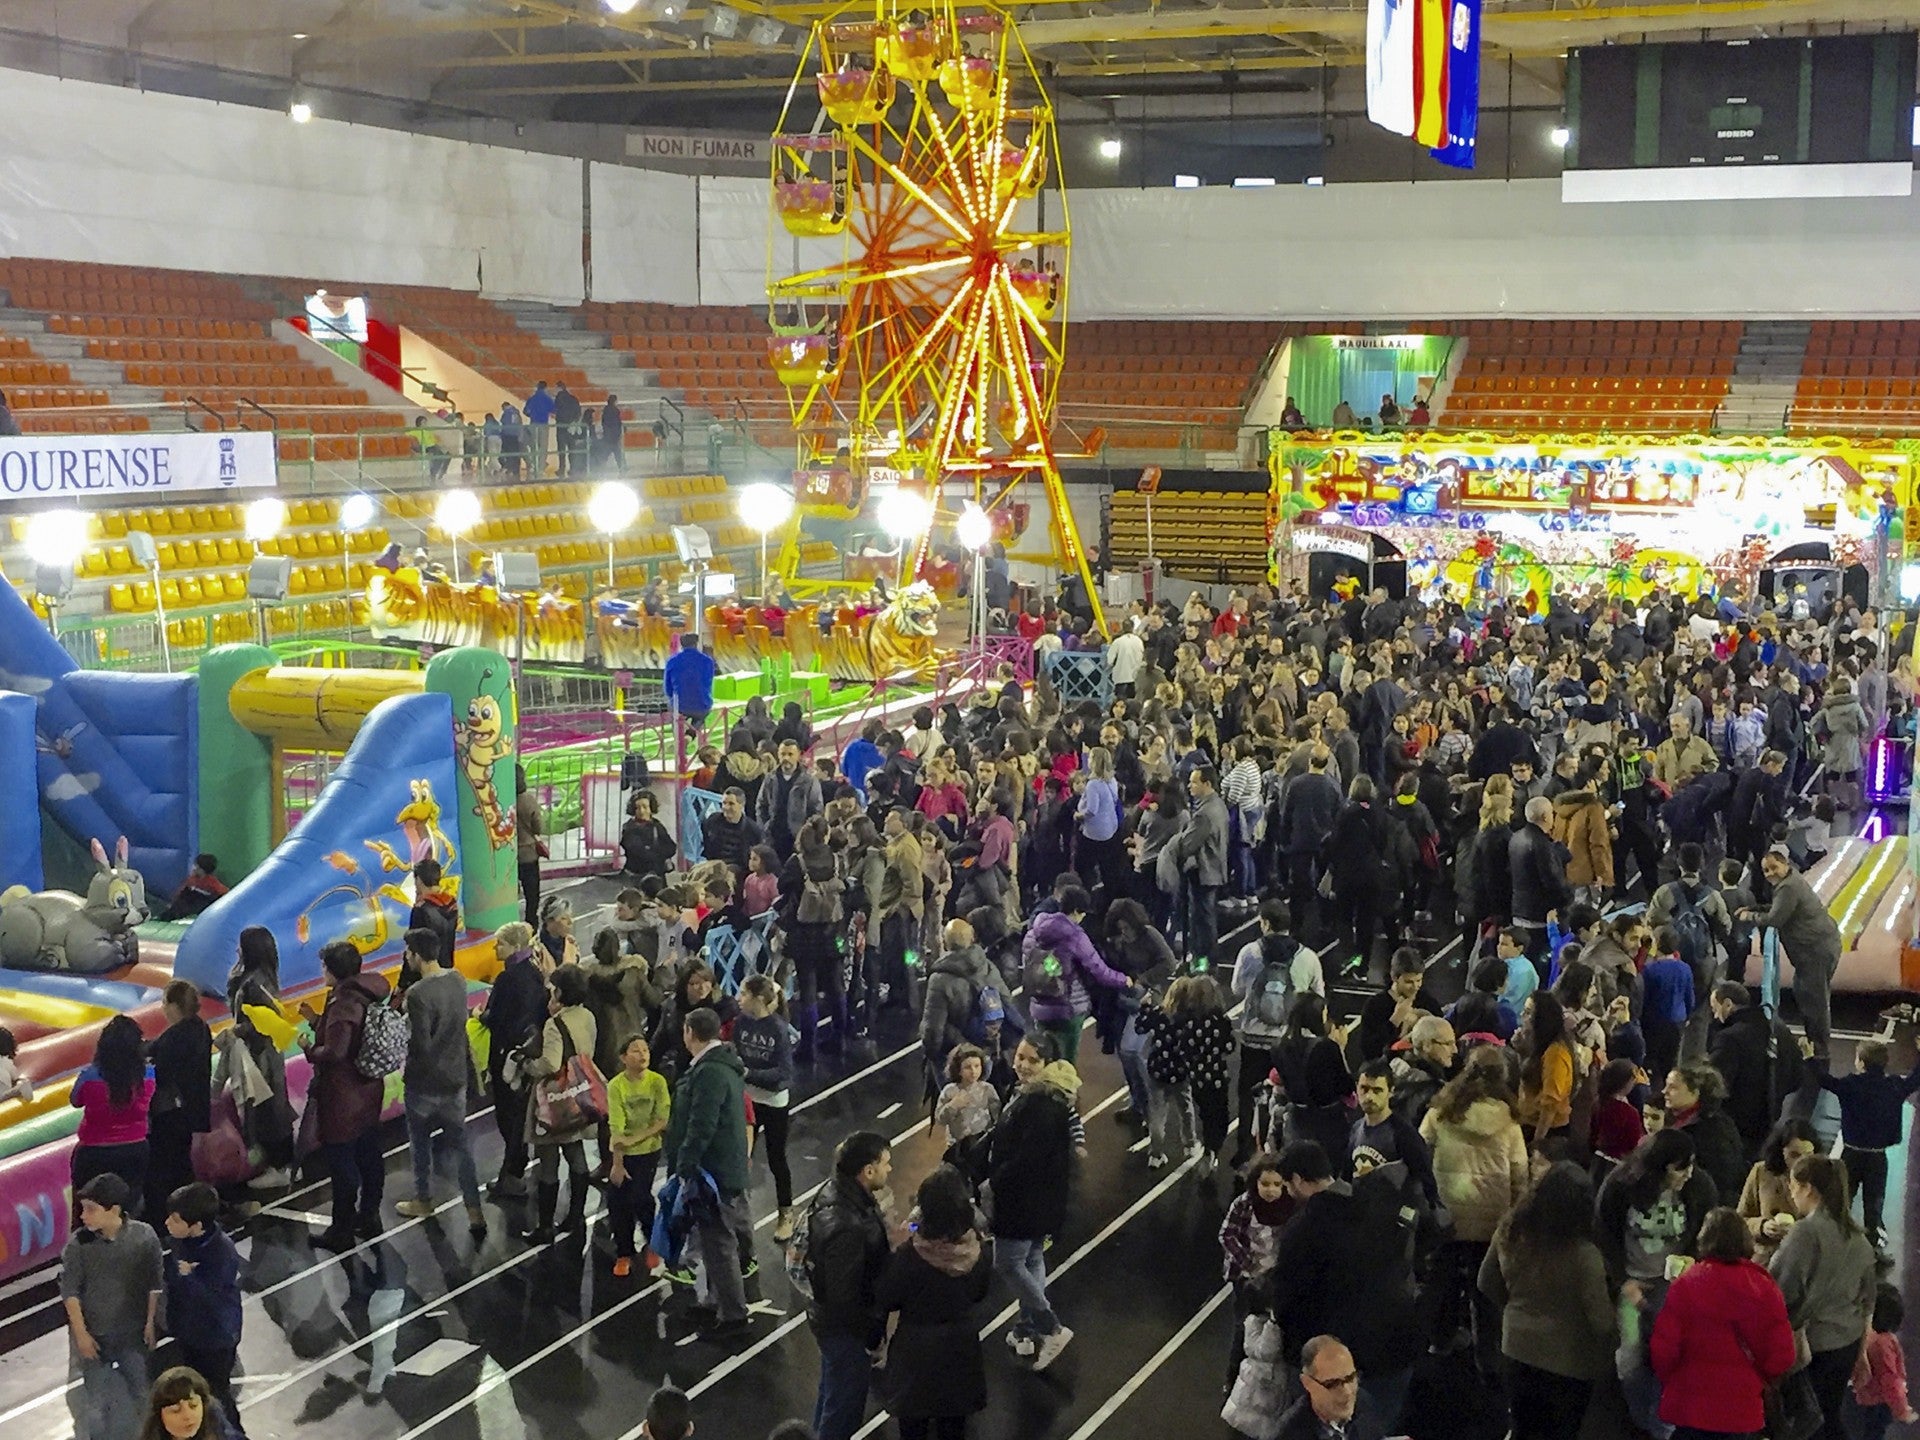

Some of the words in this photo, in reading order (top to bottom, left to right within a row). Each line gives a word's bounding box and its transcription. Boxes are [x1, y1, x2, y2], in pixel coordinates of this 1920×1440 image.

[1717, 130, 1754, 138] MONDO
[643, 138, 684, 155] NON
[692, 140, 755, 158] FUMAR
[1, 447, 172, 493] OURENSE
